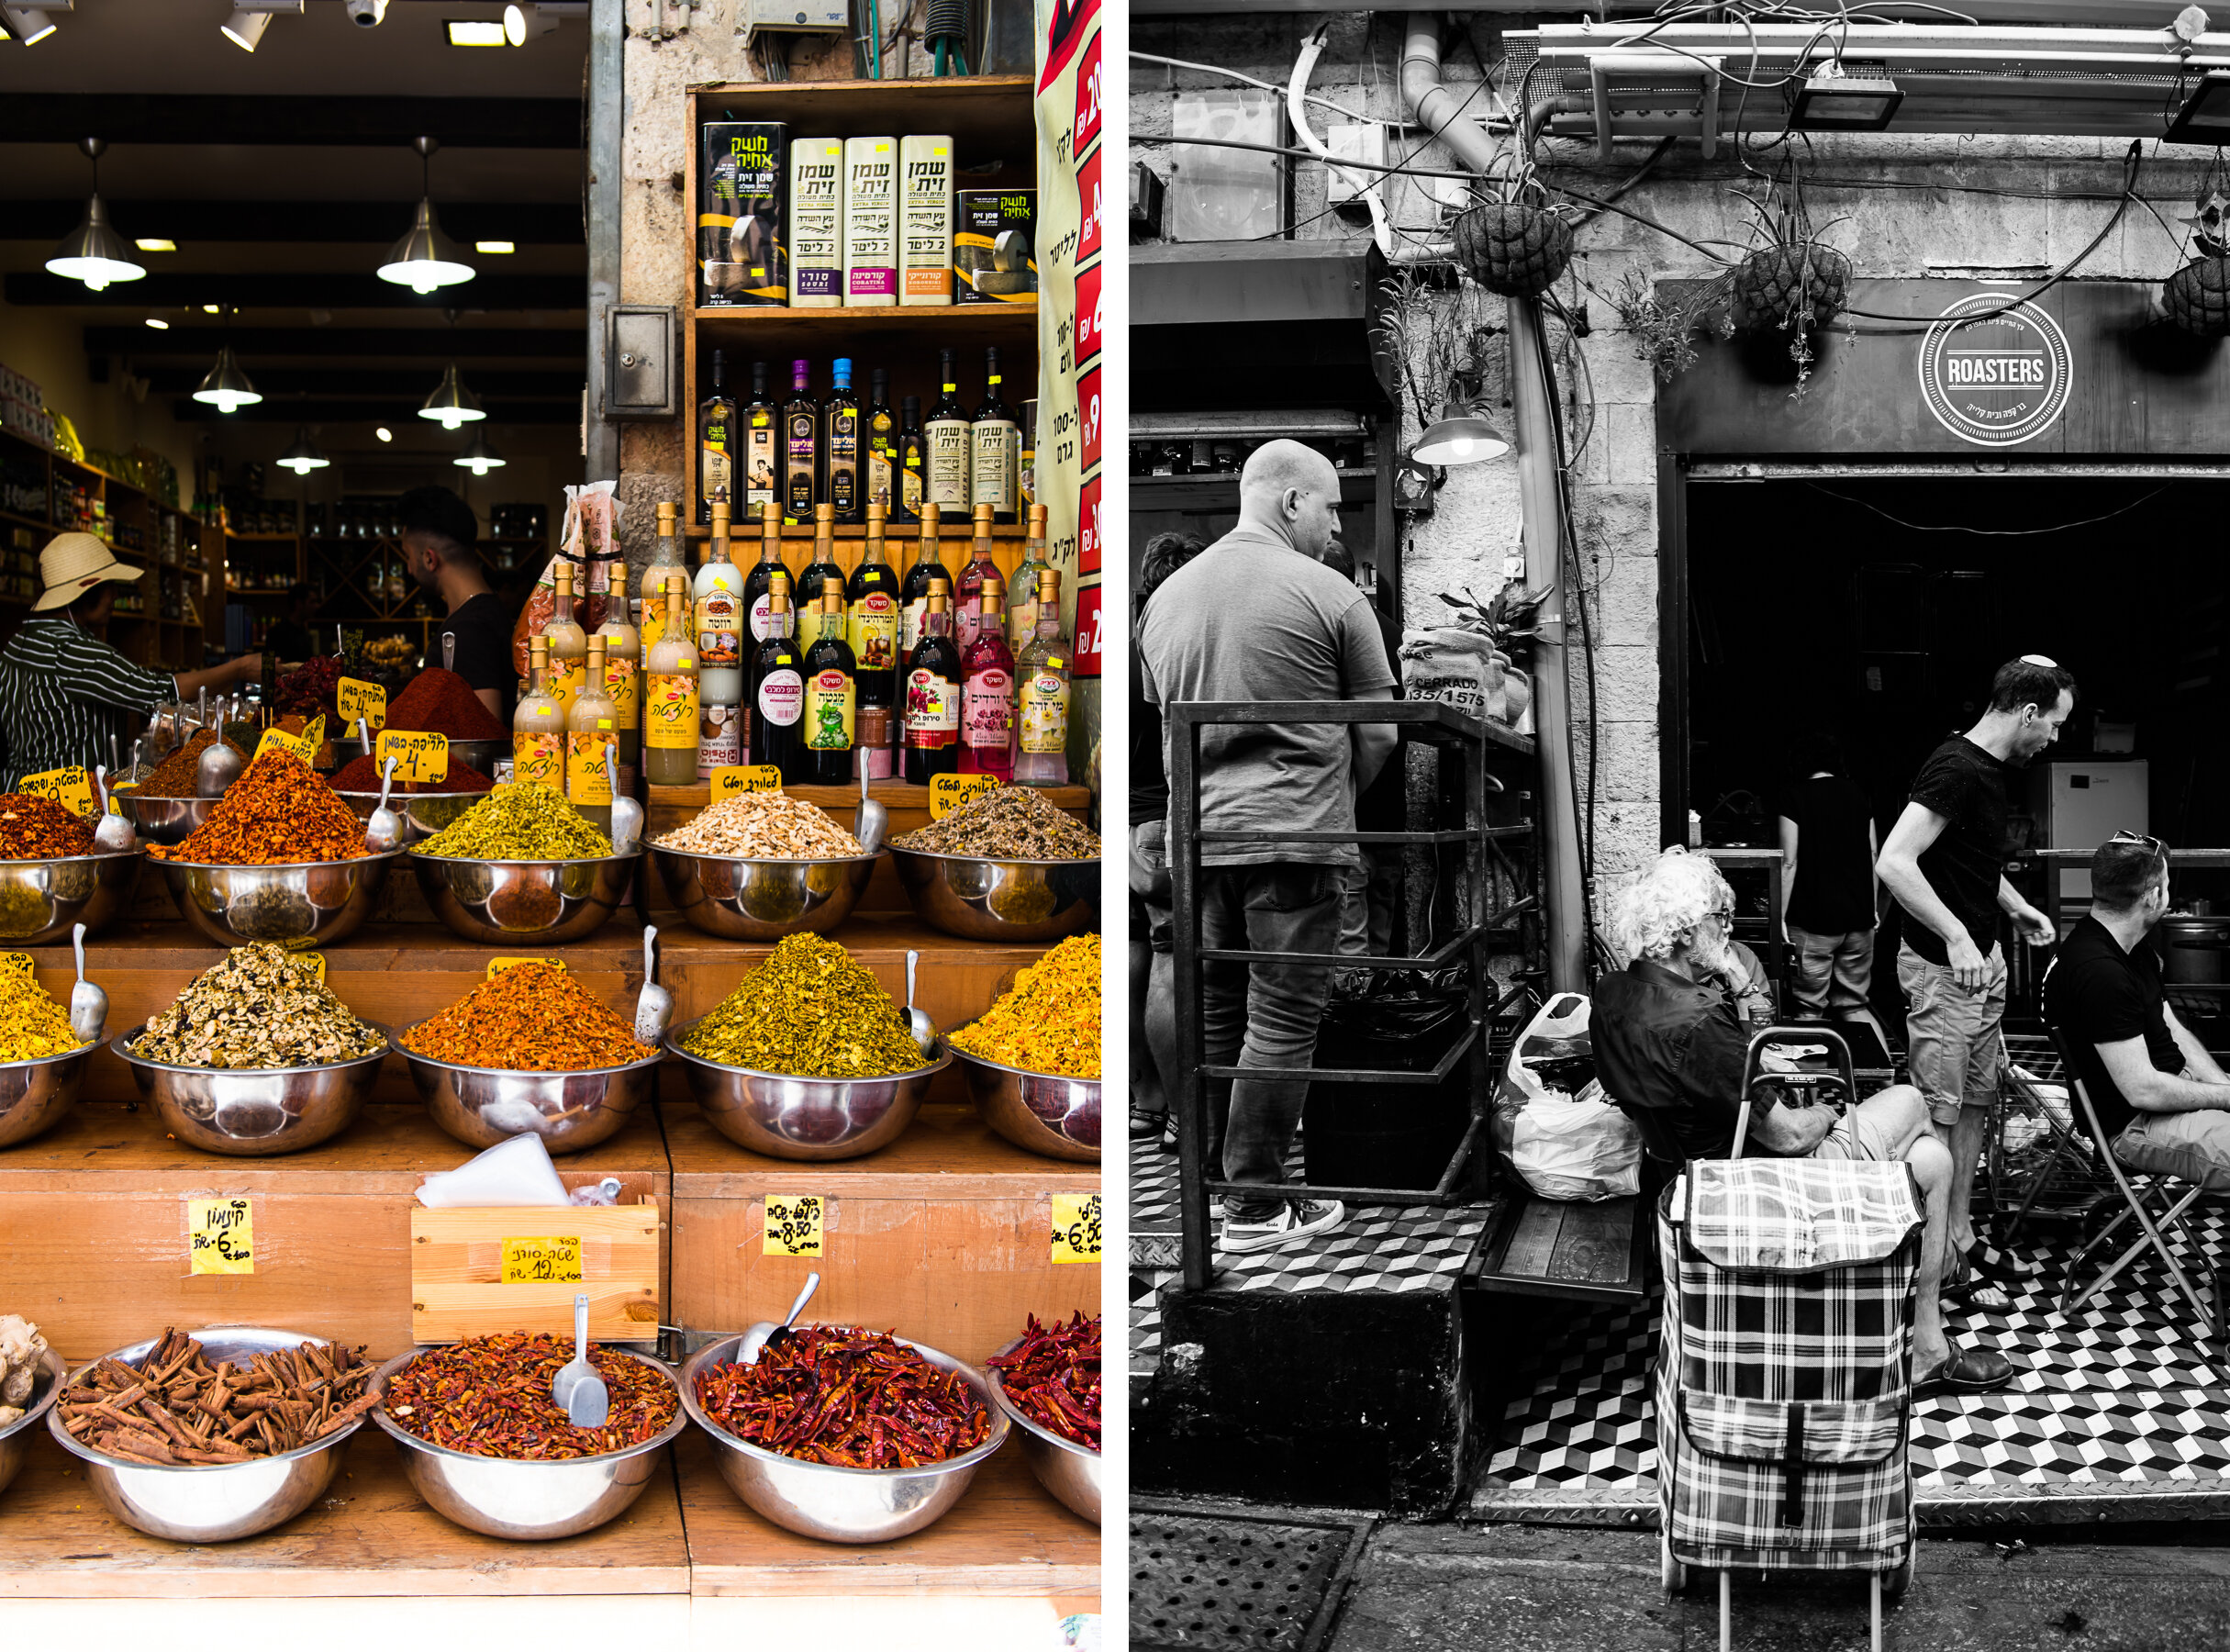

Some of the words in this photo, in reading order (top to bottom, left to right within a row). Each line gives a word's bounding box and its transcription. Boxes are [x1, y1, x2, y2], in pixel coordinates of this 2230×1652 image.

[731, 136, 767, 156] משק
[798, 165, 835, 181] שמן
[853, 163, 890, 181] שמן
[909, 162, 946, 178] שמן
[738, 173, 753, 182] זית
[756, 173, 773, 184] שמן
[807, 181, 835, 194] זית
[861, 180, 890, 193] זית
[917, 178, 946, 191] זית
[1000, 195, 1026, 209] משק
[822, 216, 834, 224] עץ
[878, 215, 889, 223] עץ
[933, 213, 945, 221] עץ
[986, 212, 998, 220] שמן
[797, 242, 823, 251] ליטר
[853, 241, 878, 251] ליטר
[883, 242, 889, 251] 2
[908, 240, 933, 250] ליטר
[1050, 229, 1076, 266] לליטר
[2001, 318, 2017, 329] החיים
[1948, 358, 2044, 383] ROASTERS
[1967, 403, 1986, 419] קלייה
[2016, 402, 2026, 410] בר
[1090, 394, 1100, 442] 9
[1987, 411, 2002, 419] ובית
[2003, 408, 2017, 419] קפה
[936, 427, 960, 439] שמן
[978, 427, 1002, 440] שמן
[942, 438, 960, 447] זית
[983, 438, 1002, 447] זית
[1057, 440, 1073, 464] גרם
[1415, 677, 1478, 690] CERRADO
[818, 693, 844, 702] מנטה
[972, 694, 1000, 704] ורדים
[356, 697, 364, 718] 4
[1029, 700, 1048, 710] זהר
[1053, 701, 1064, 711] מי
[701, 749, 726, 758] Asia
[406, 749, 418, 777] 4
[207, 1208, 243, 1230] קינמון
[218, 1231, 231, 1253] 6
[532, 1260, 555, 1279] 12
